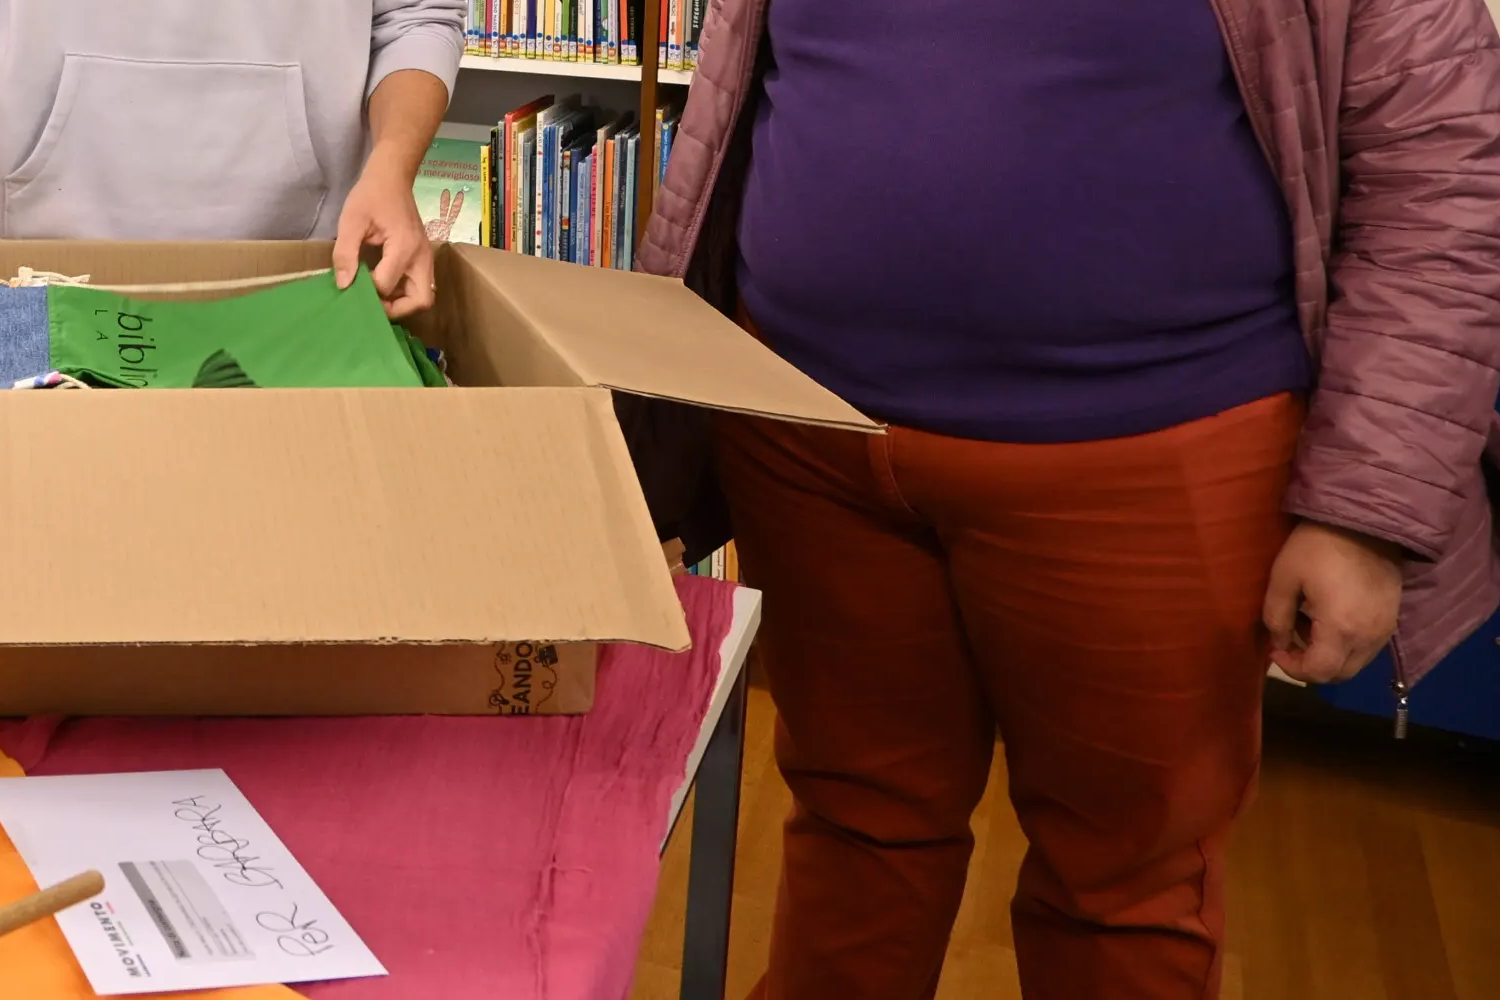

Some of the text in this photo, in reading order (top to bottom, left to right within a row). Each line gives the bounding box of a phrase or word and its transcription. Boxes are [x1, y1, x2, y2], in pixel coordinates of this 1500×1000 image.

[428, 160, 477, 170] spaventoso
[424, 169, 479, 181] meraviglioso
[90, 900, 142, 978] MOVIMENTO
